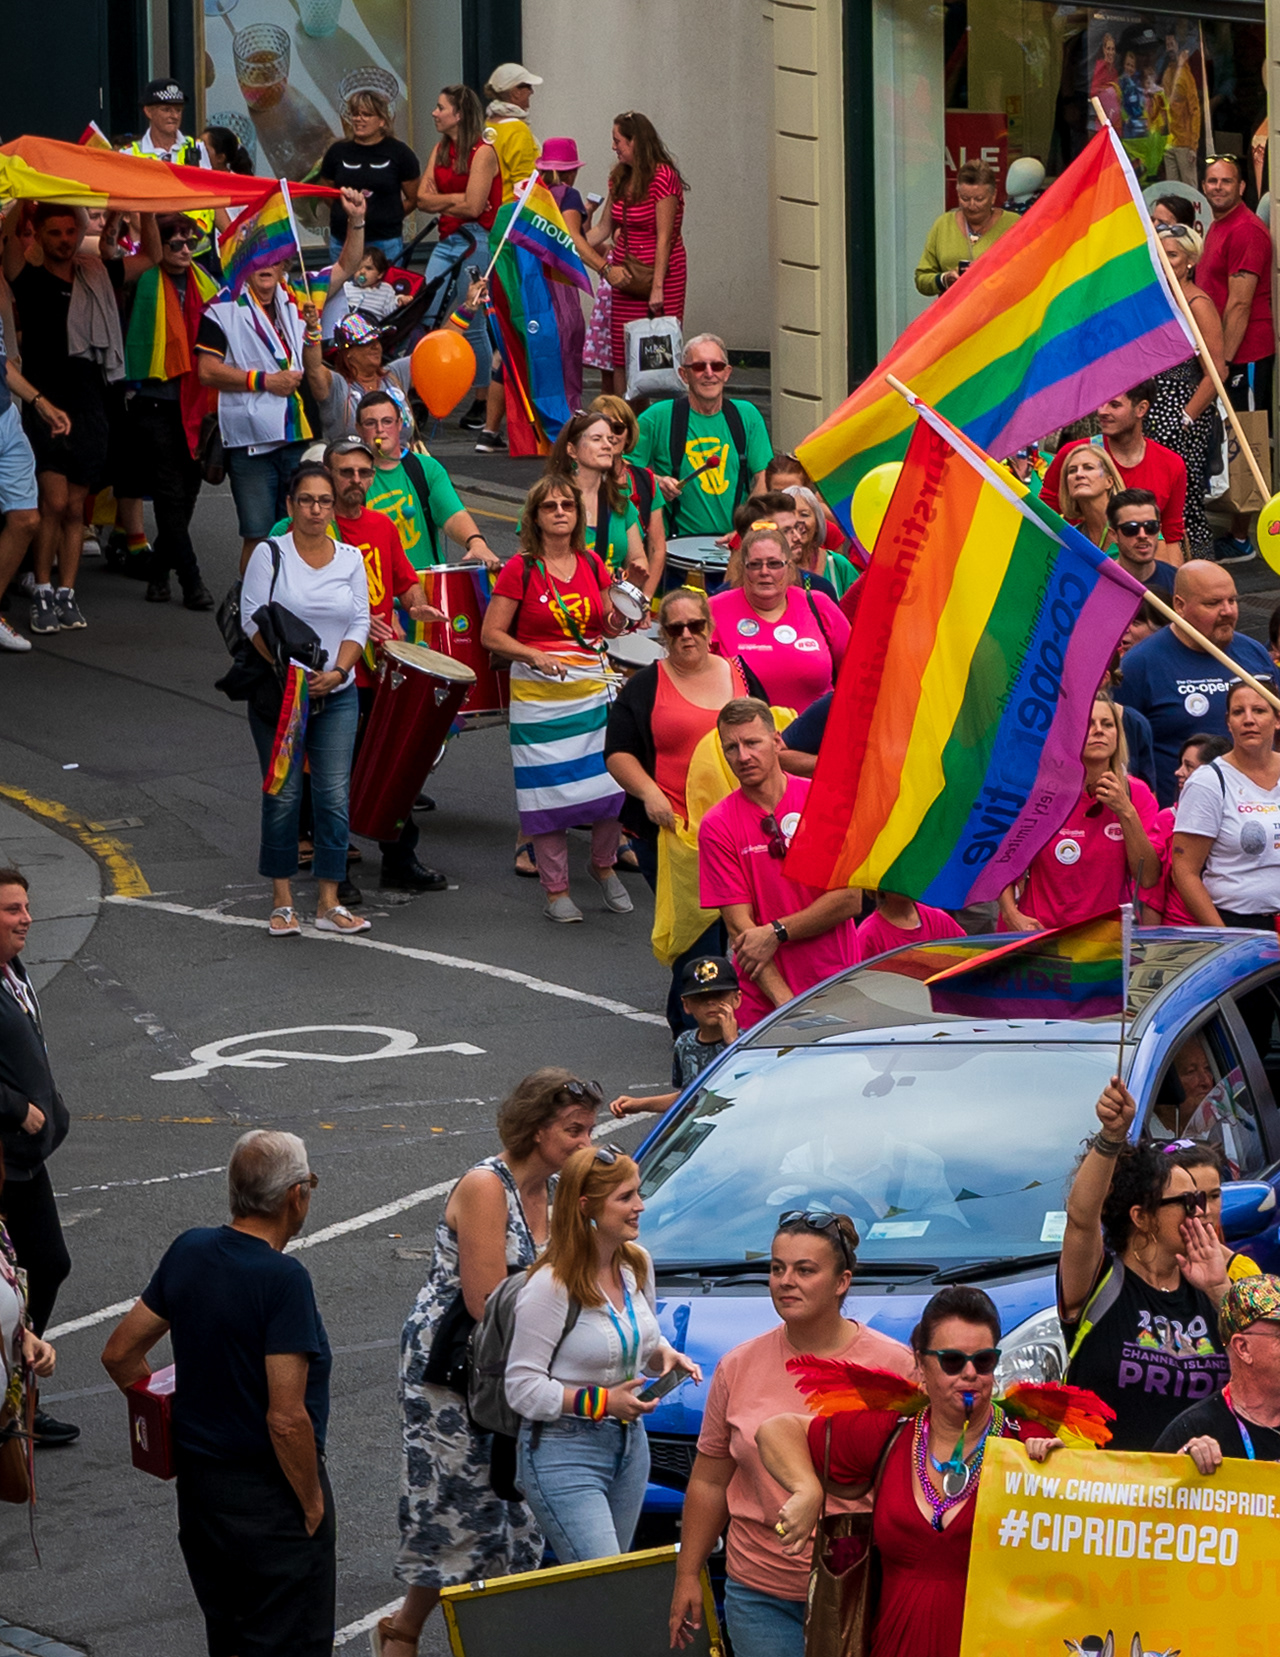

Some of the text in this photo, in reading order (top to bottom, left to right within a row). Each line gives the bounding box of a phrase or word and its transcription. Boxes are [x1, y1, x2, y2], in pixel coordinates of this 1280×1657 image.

[945, 147, 1000, 173] ALE
[1121, 1347, 1229, 1373] CHANNEL ISLAND
[998, 1509, 1240, 1566] #CIPRIDE2020
